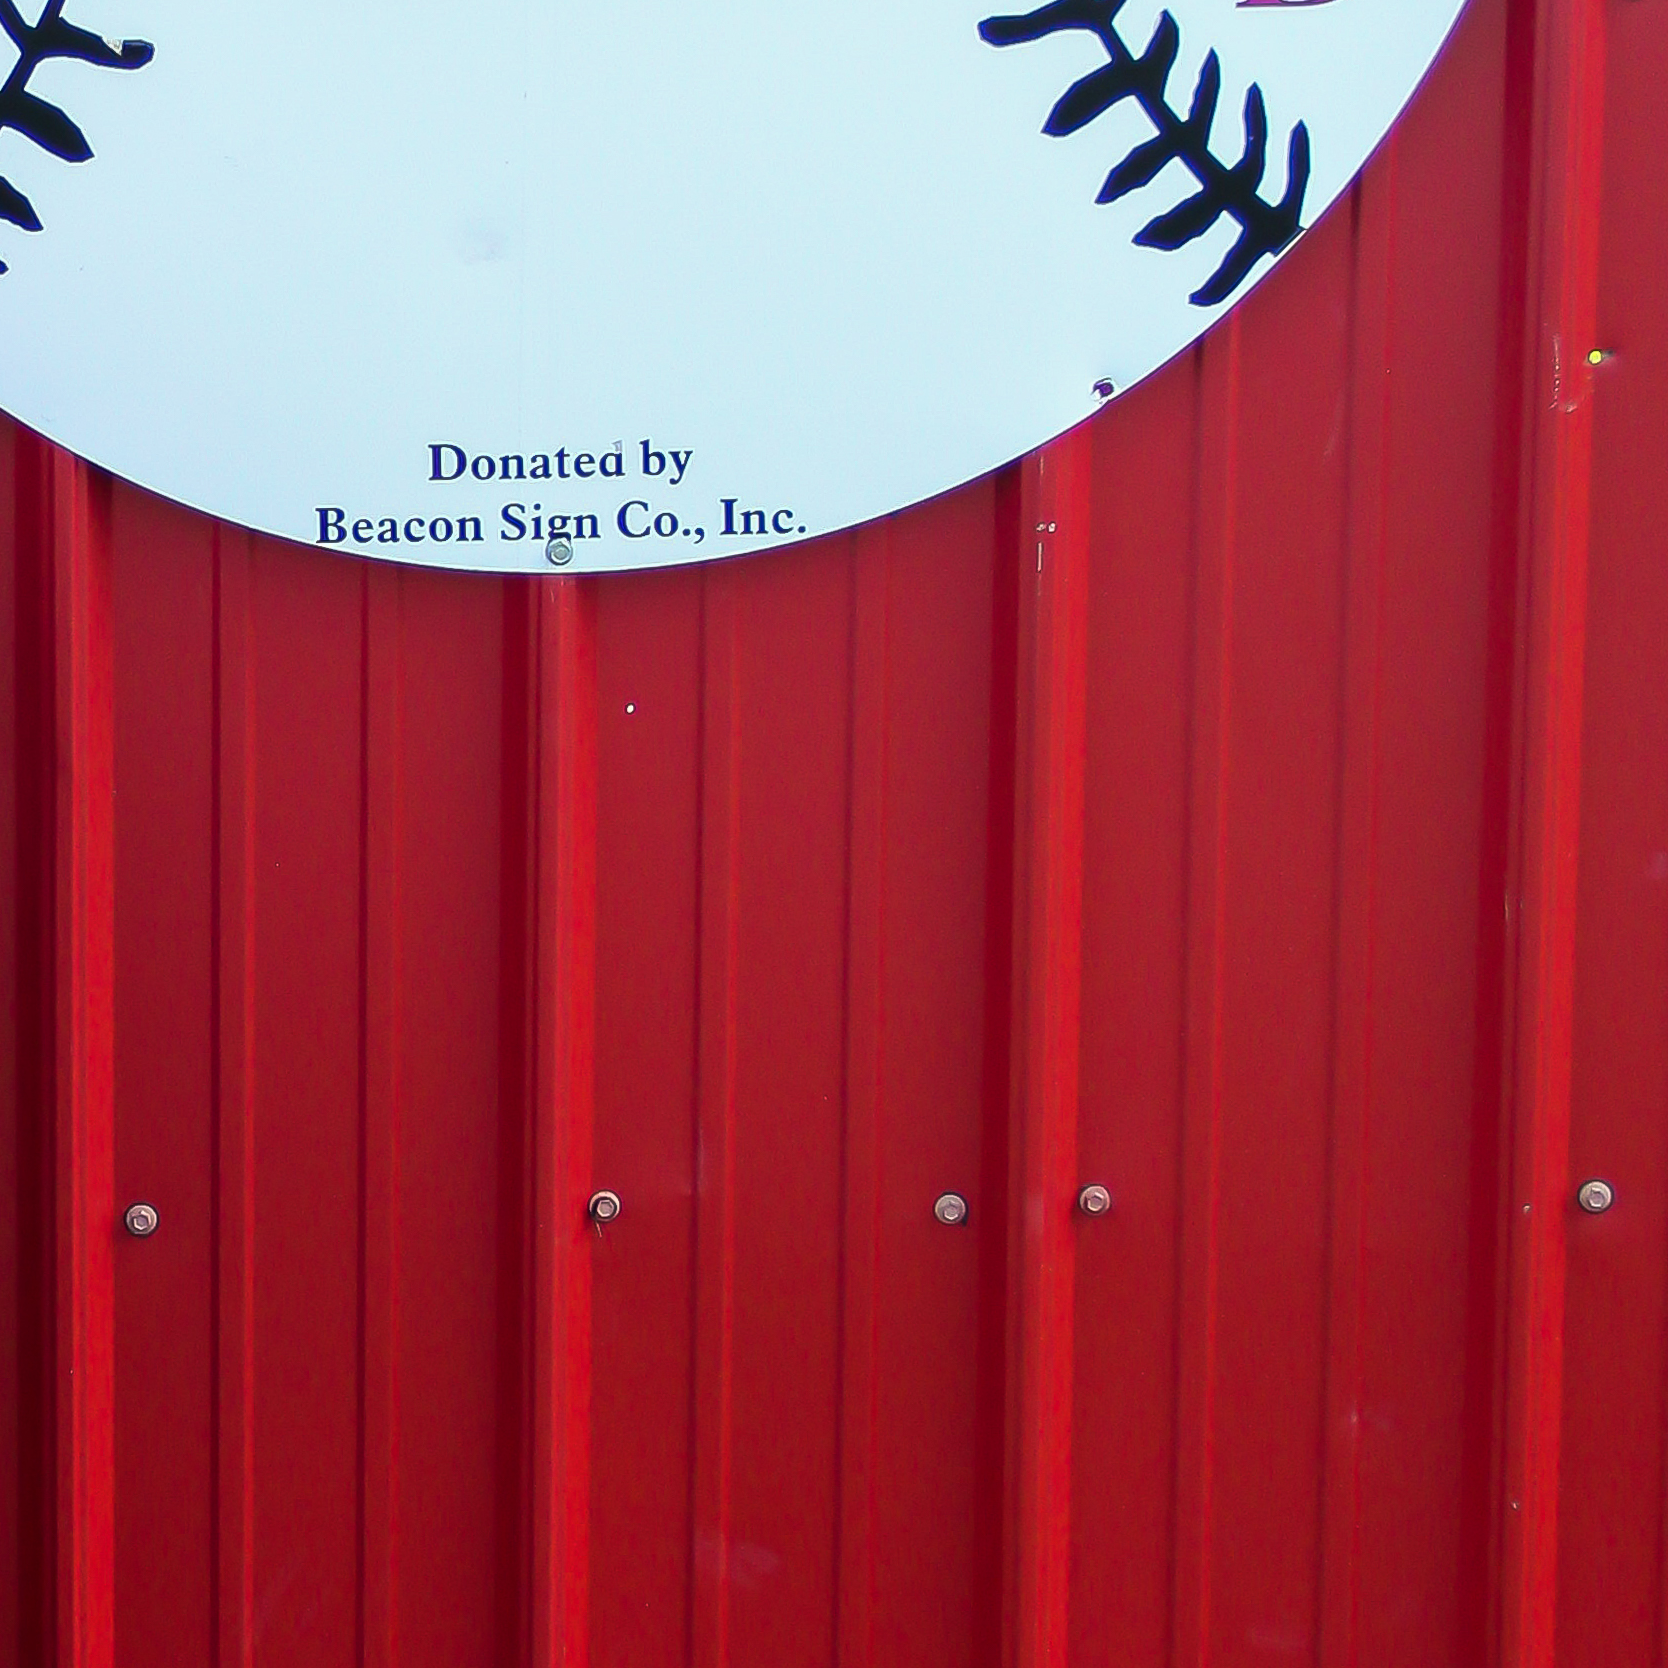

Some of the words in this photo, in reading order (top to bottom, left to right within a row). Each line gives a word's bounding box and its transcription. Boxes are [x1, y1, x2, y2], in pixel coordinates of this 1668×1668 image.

[428, 440, 625, 481] Donated
[640, 439, 693, 485] by
[315, 507, 483, 544] Beacon
[500, 502, 601, 543] Sign
[617, 500, 705, 544] Co.,
[720, 498, 807, 536] Inc.
